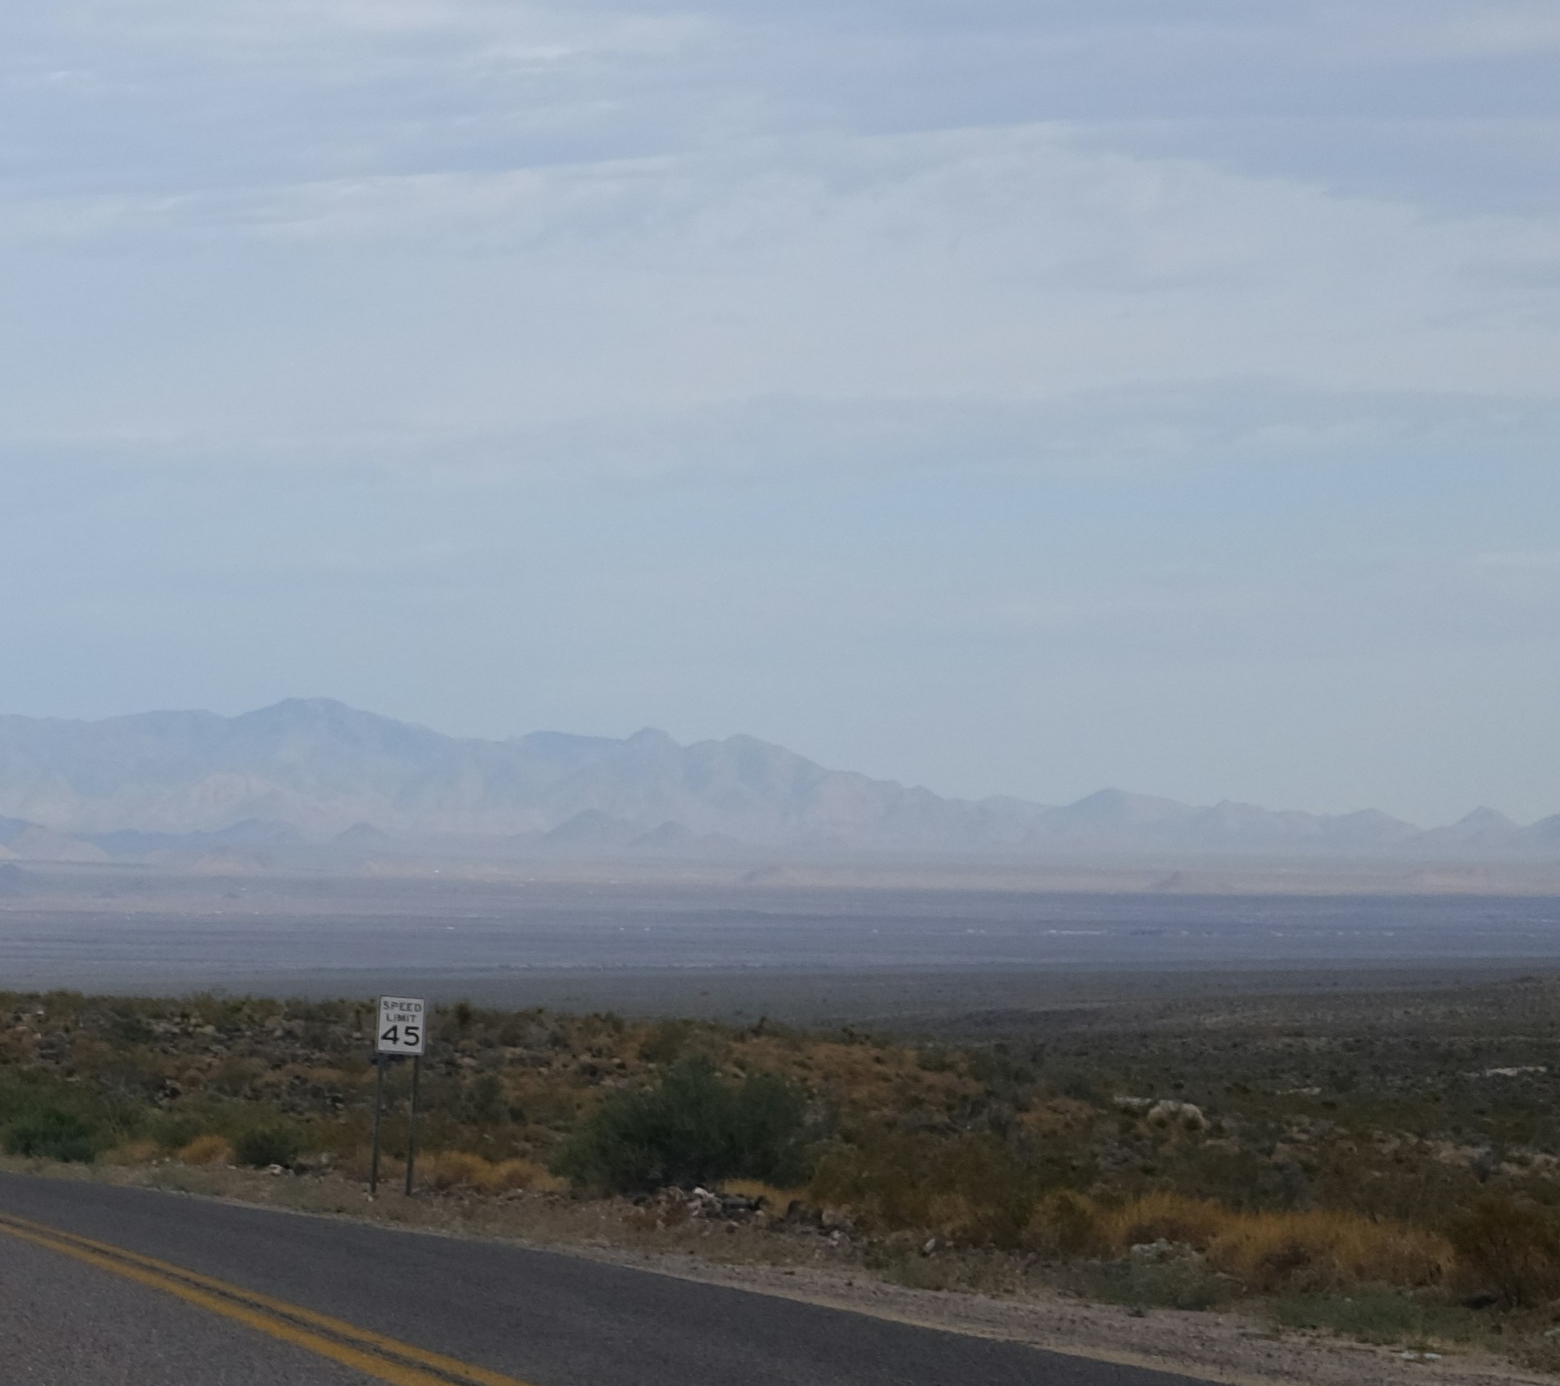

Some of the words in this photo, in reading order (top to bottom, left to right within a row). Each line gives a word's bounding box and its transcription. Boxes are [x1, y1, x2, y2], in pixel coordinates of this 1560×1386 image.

[383, 1001, 422, 1012] SPEED
[386, 1013, 417, 1023] LIMIT
[381, 1025, 420, 1046] 45
